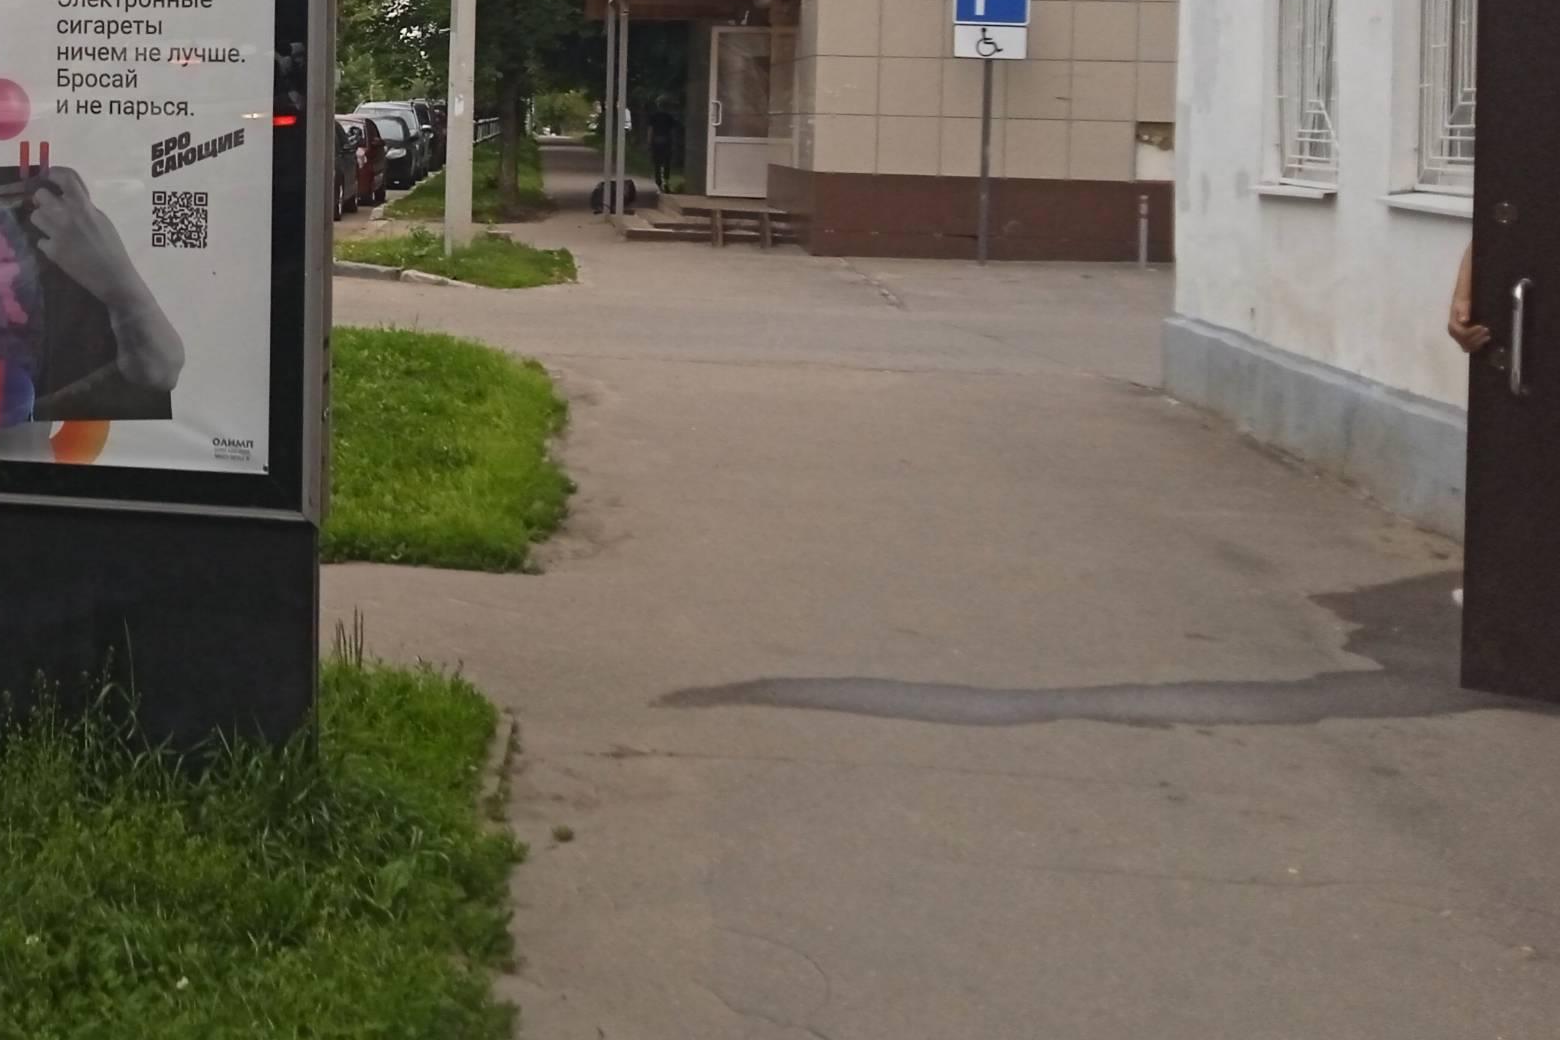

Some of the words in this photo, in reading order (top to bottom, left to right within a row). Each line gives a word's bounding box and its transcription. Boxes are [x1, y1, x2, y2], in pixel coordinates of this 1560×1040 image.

[56, 17, 163, 39] сигареты
[56, 45, 127, 63] ничем
[135, 46, 161, 63] не
[167, 46, 246, 67] лучше.
[56, 68, 138, 92] Бросай
[56, 99, 69, 115] и
[76, 99, 102, 115] не
[108, 99, 195, 120] парься.
[150, 130, 191, 162] БРО
[150, 127, 245, 179] САЮЩИЕ
